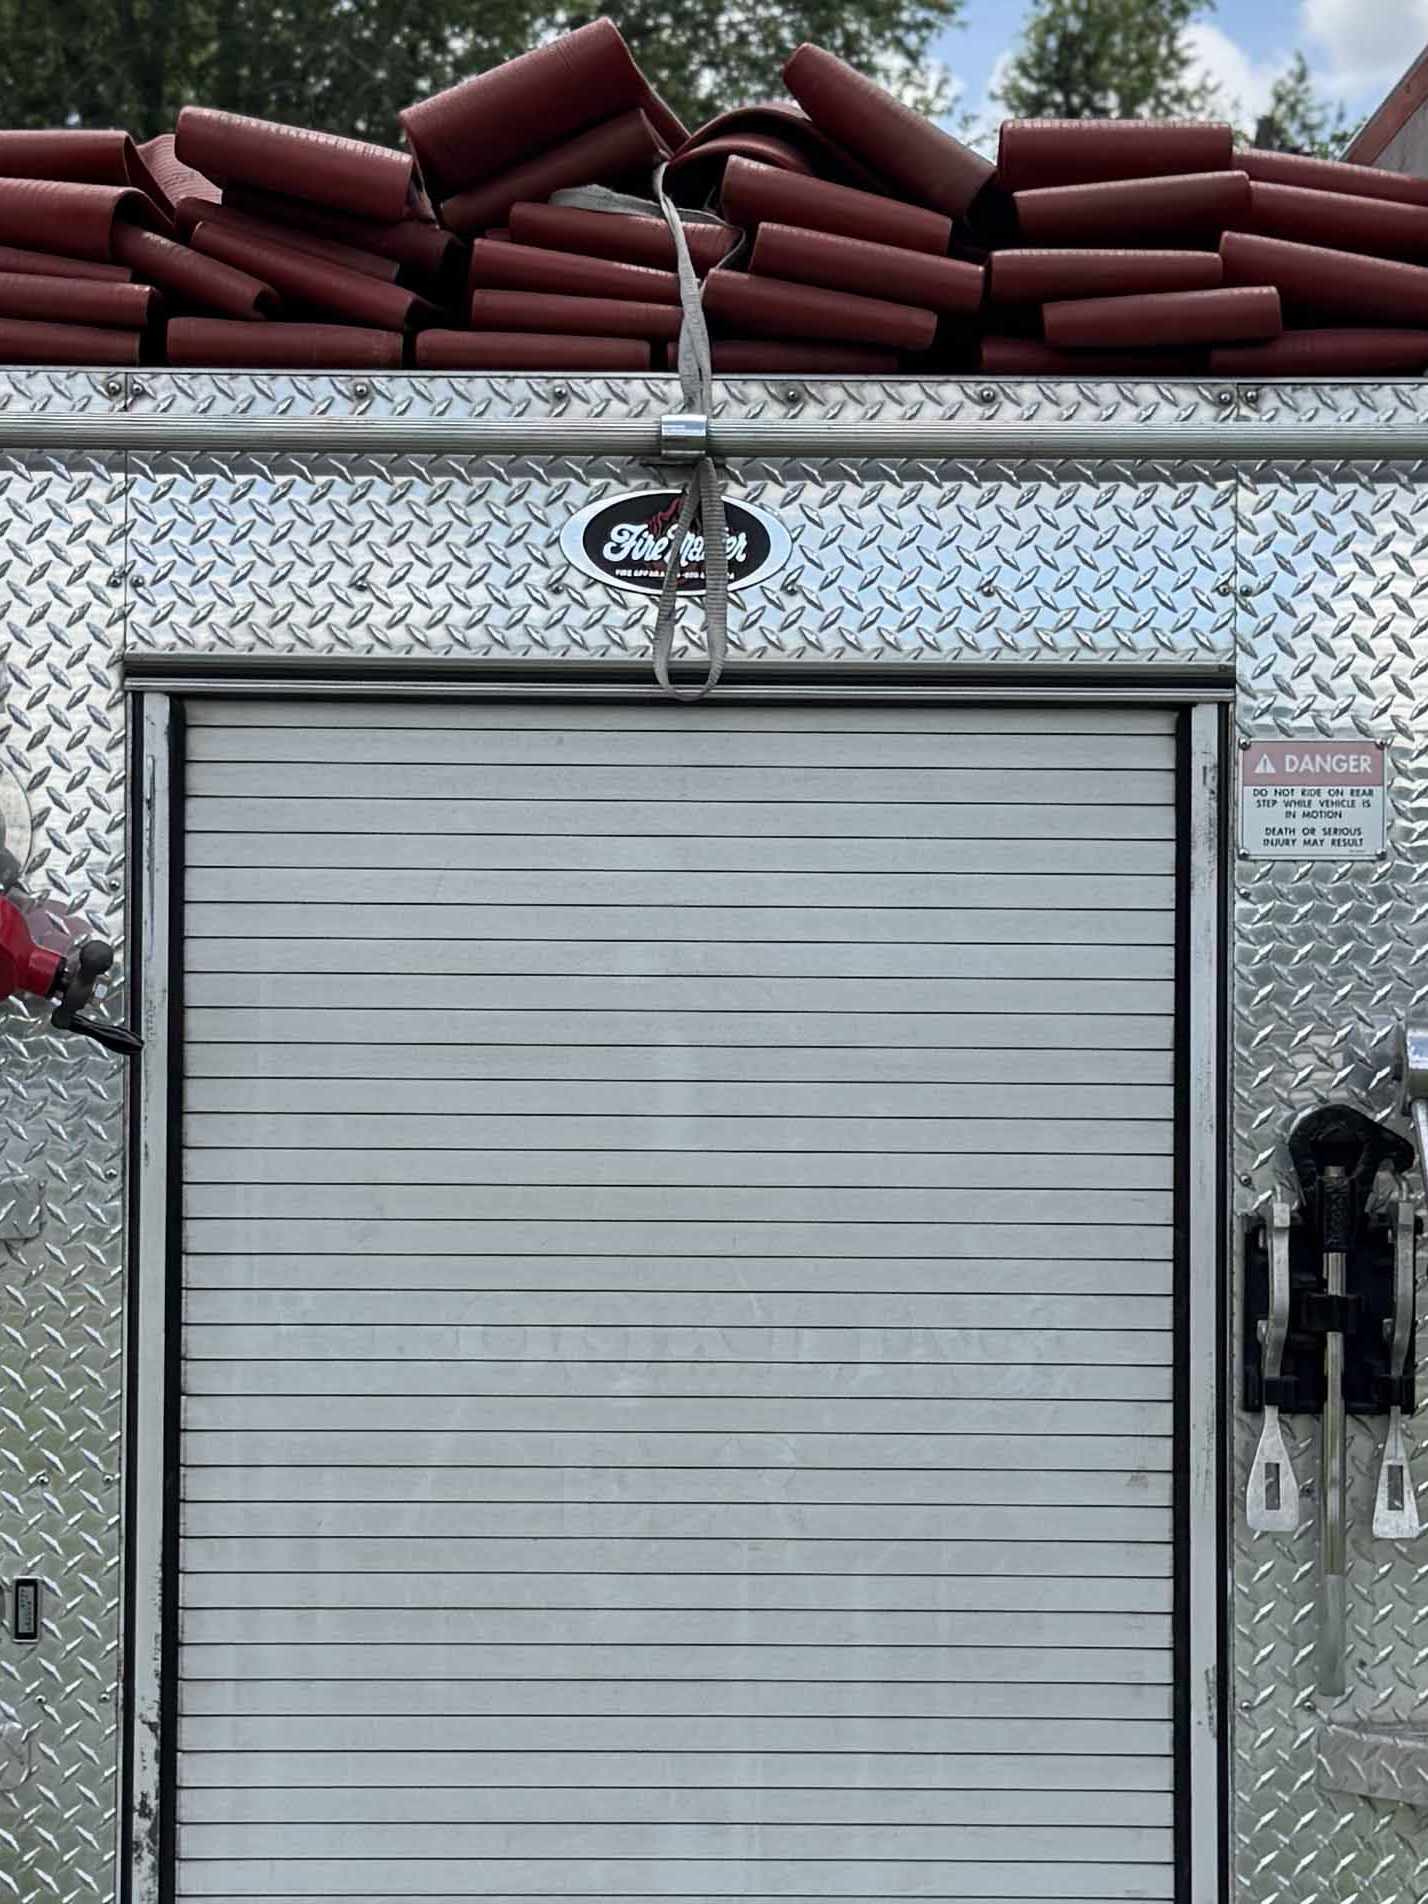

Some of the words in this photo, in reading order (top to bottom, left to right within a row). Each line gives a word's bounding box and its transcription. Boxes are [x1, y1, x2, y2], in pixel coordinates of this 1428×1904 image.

[1284, 754, 1372, 774] DANGER
[1252, 788, 1268, 798] DO
[1274, 788, 1295, 798] NOT
[1300, 788, 1322, 798] RIDE
[1327, 788, 1344, 798] ON
[1350, 788, 1374, 798] REAR
[1256, 799, 1277, 808] STEP
[1283, 799, 1312, 808] WHILE
[1318, 799, 1356, 808] VEHICLE
[1362, 799, 1372, 808] IS
[1285, 810, 1296, 819] IN
[1301, 810, 1343, 819] MOTION
[1264, 827, 1296, 836] DEATH
[1301, 827, 1316, 836] OR
[1323, 827, 1362, 836] SERIOUS
[1263, 838, 1296, 847] INJURY
[1303, 838, 1325, 847] MAY
[1331, 838, 1364, 847] RESULT
